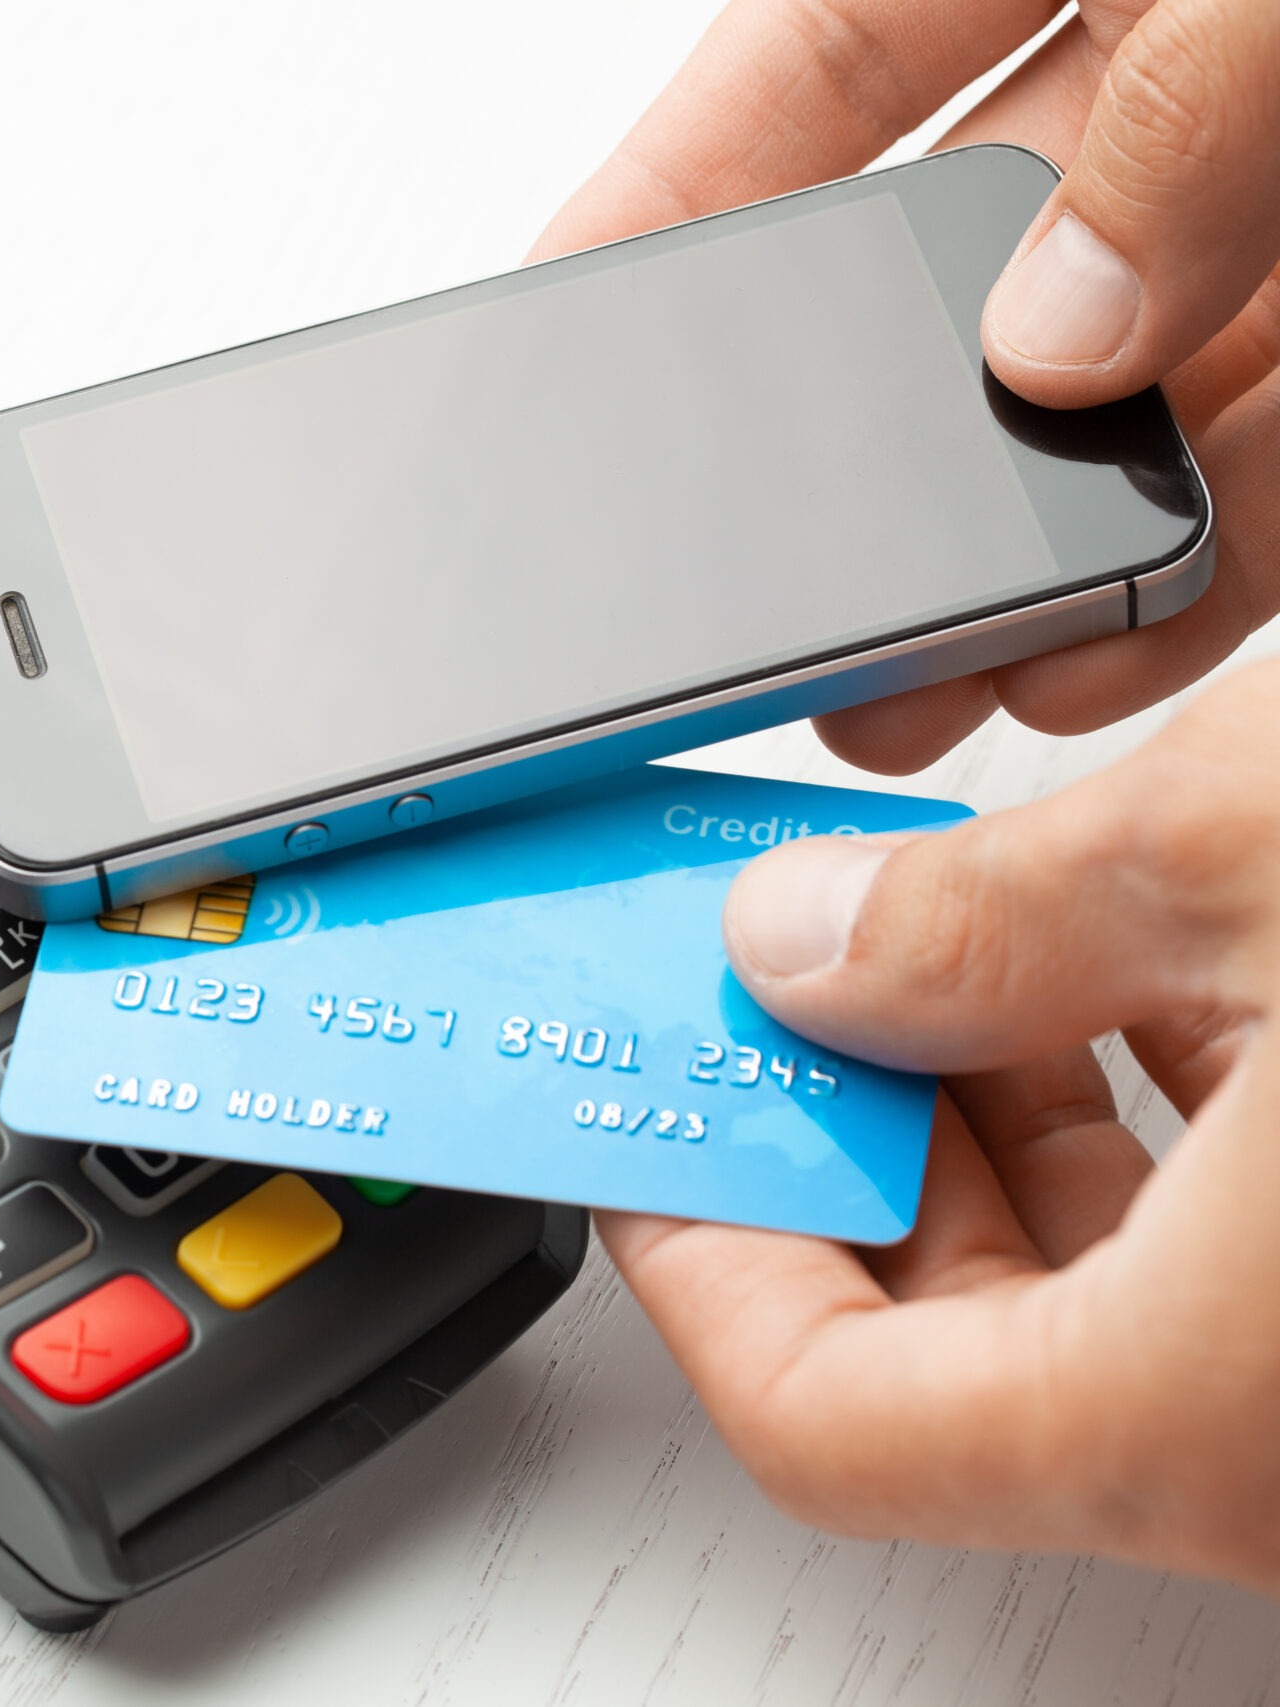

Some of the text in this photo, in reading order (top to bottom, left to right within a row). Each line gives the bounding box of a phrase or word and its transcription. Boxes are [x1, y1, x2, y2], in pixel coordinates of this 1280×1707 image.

[663, 804, 812, 846] Credit
[113, 970, 842, 1098] 0123 4567 8901 2345
[93, 1073, 389, 1136] CARD HOLDER
[573, 1099, 709, 1143] 08/23
